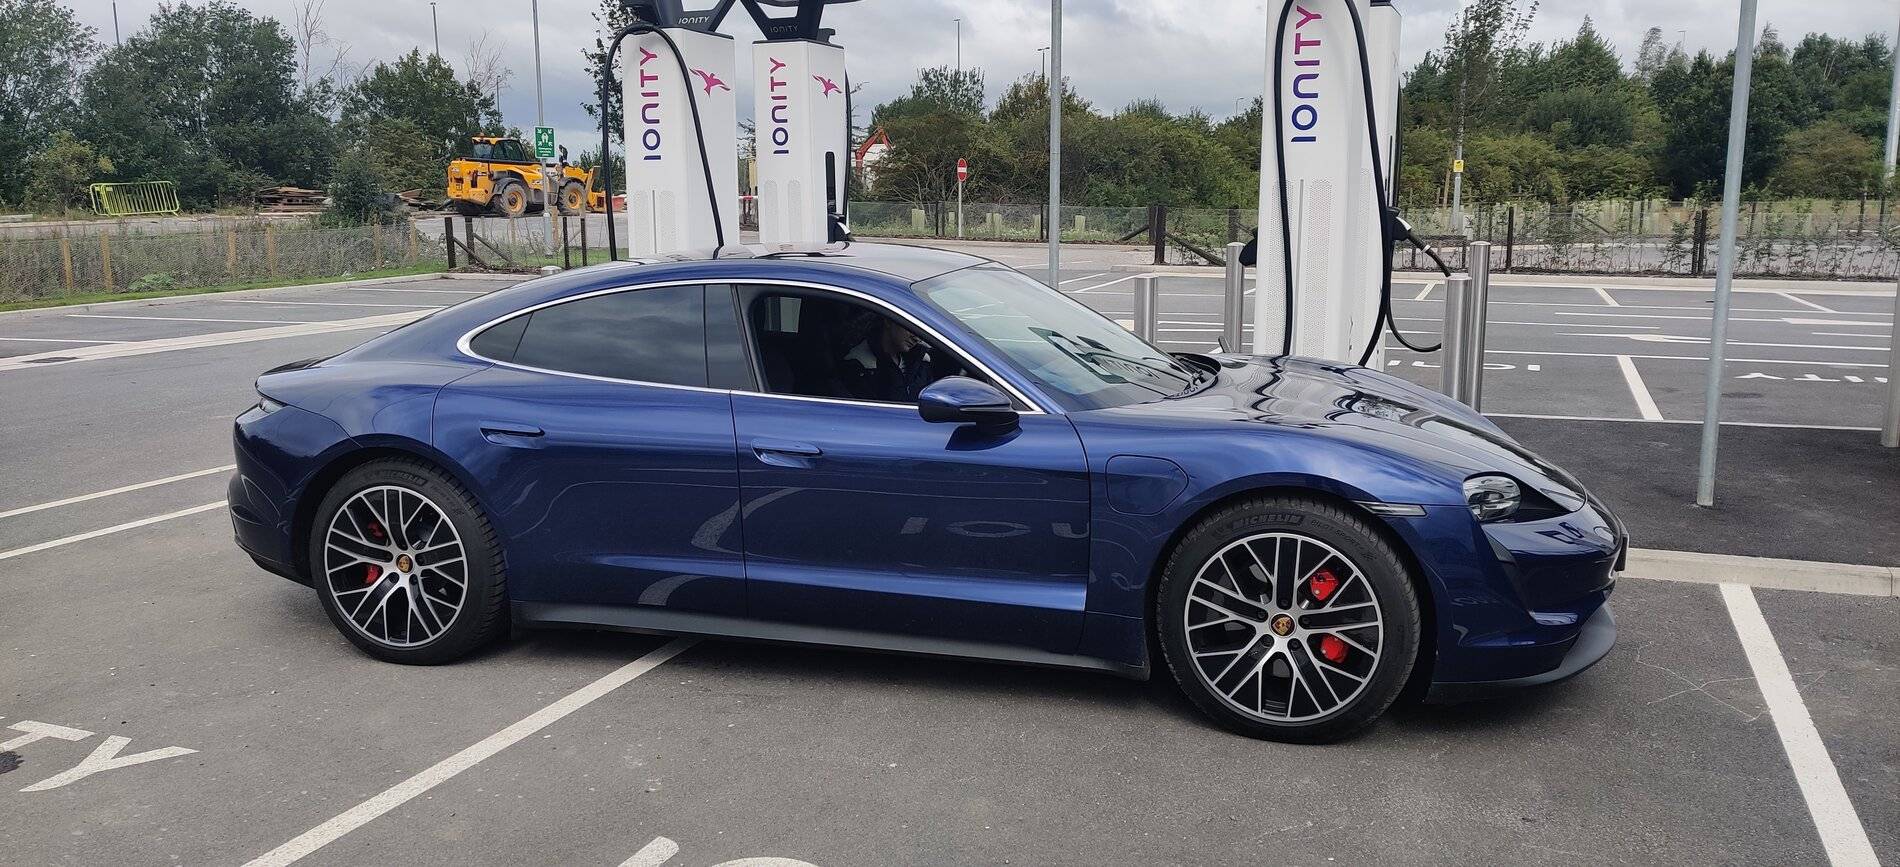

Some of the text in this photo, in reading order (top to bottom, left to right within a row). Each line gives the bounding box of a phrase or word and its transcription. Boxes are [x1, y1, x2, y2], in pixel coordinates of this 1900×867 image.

[678, 16, 710, 24] IONITY
[770, 25, 799, 33] IONITY
[639, 46, 661, 160] IONITY
[769, 57, 789, 154] IONITY
[1291, 5, 1322, 142] IONITY
